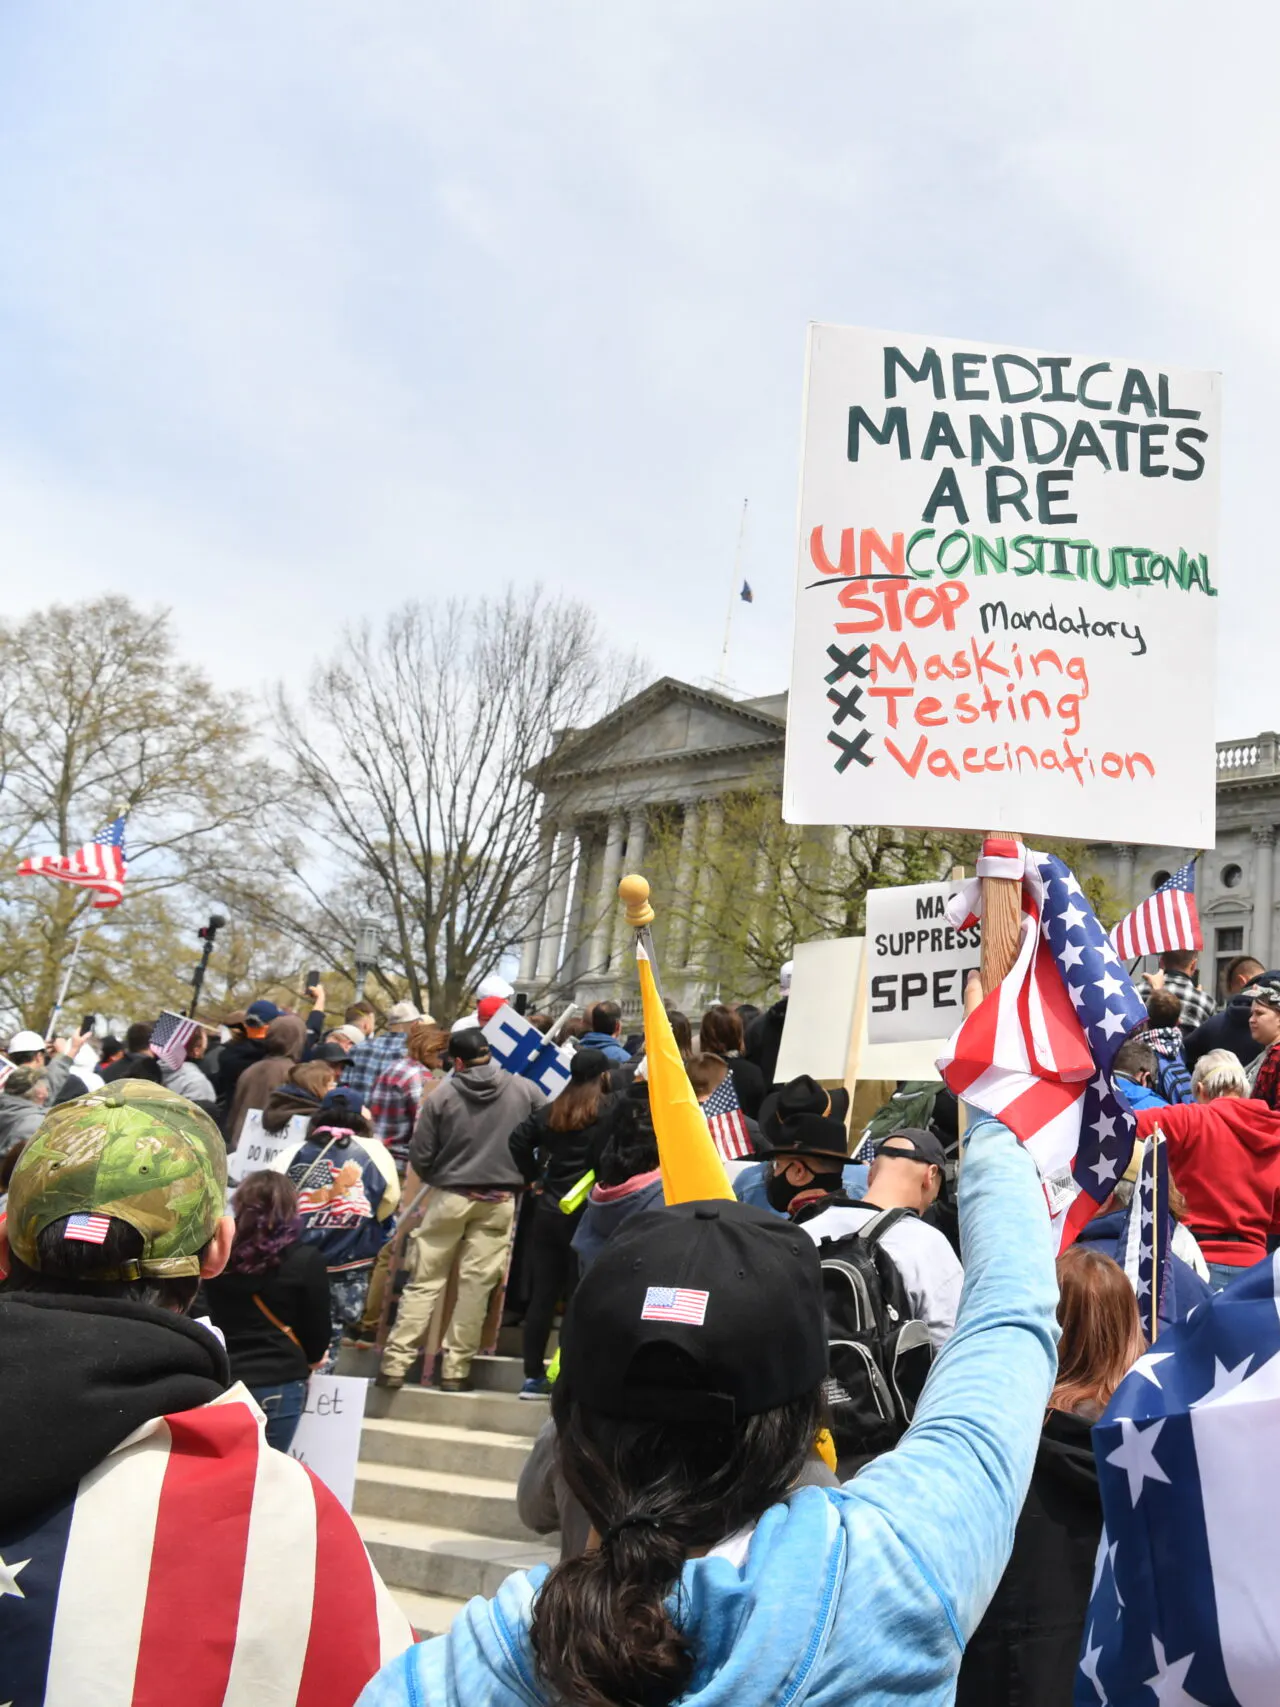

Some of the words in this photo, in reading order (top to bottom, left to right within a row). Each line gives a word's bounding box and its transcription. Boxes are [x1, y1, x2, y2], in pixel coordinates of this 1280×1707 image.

[883, 347, 1201, 421] MEDICAL
[847, 406, 1208, 481] MANDATES
[921, 466, 1078, 524] ARE
[810, 525, 1218, 596] UNCONSTITUTIONAL
[833, 580, 970, 634] STOP
[979, 600, 1147, 655] Mandatory
[867, 636, 1089, 699] Masking
[867, 683, 1084, 735] Testing
[884, 734, 1156, 788] Vaccination
[916, 893, 957, 920] MA
[247, 1145, 261, 1161] DO
[263, 1147, 283, 1164] NO
